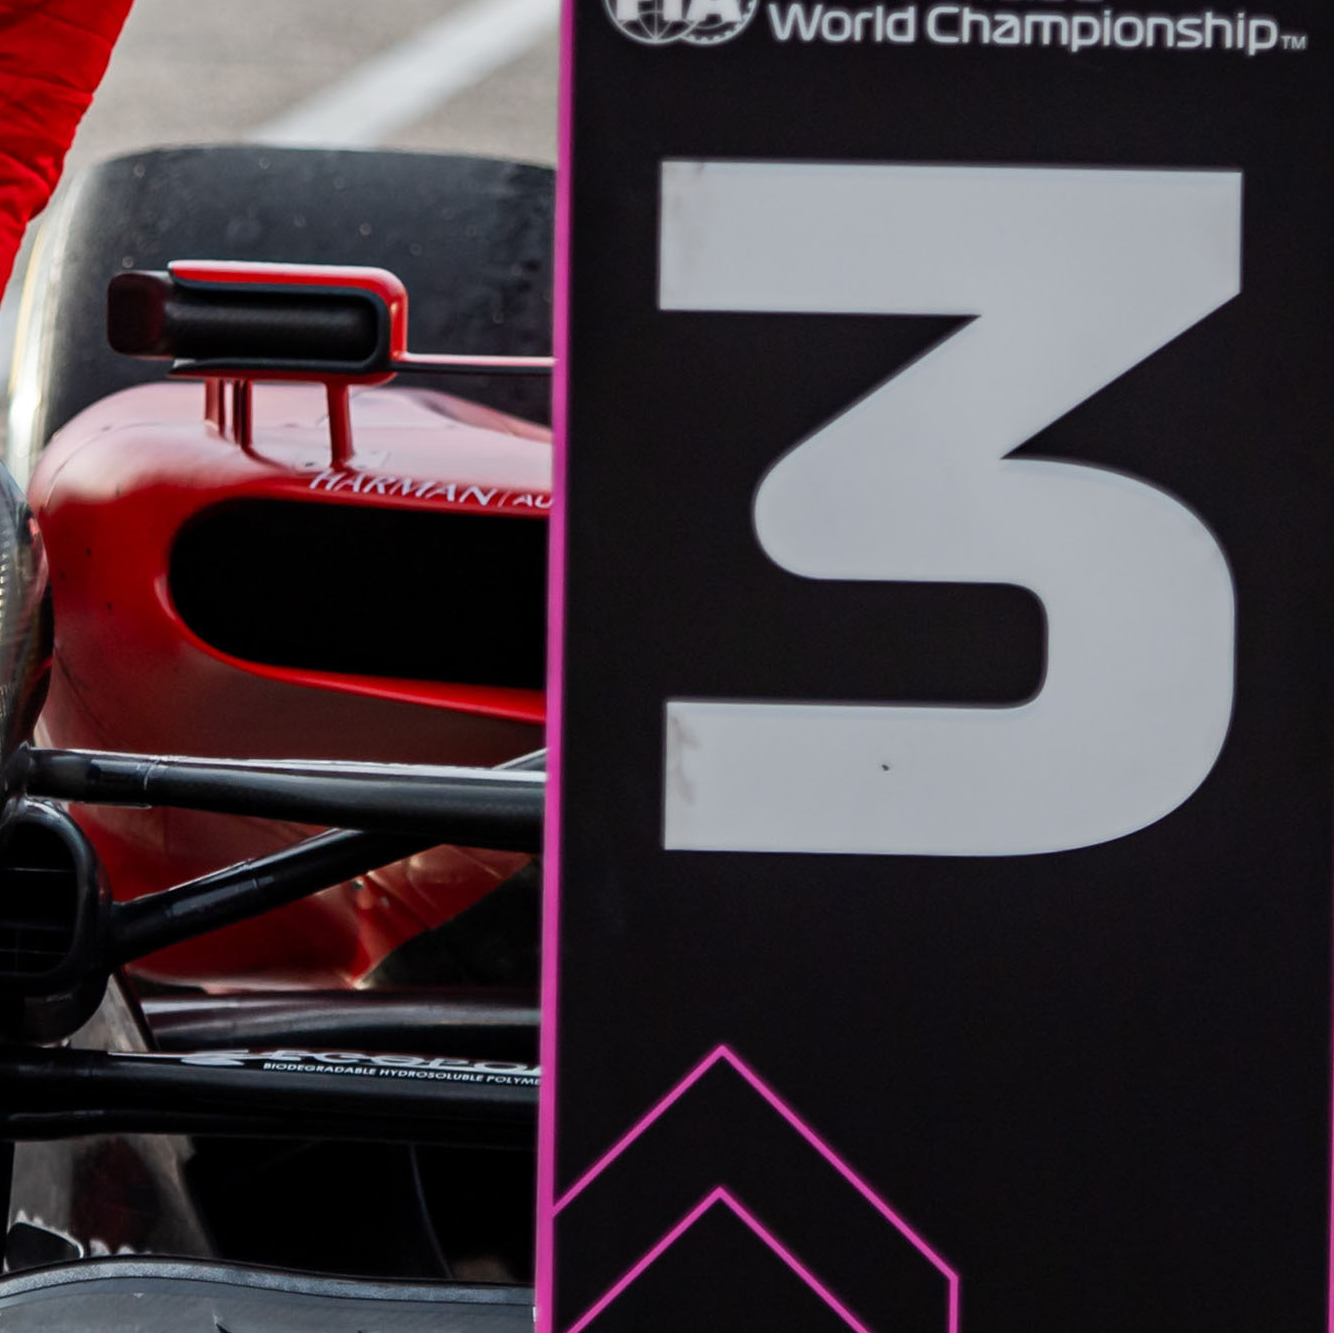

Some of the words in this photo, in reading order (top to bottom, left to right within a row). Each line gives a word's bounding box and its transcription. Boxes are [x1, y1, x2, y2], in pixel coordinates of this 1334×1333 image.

[769, 2, 916, 45] World
[310, 469, 497, 508] HARMAN
[658, 160, 1244, 858] 3
[263, 1062, 376, 1077] BIODEGRADABLE
[378, 1068, 485, 1084] HYDROSOLUBLE
